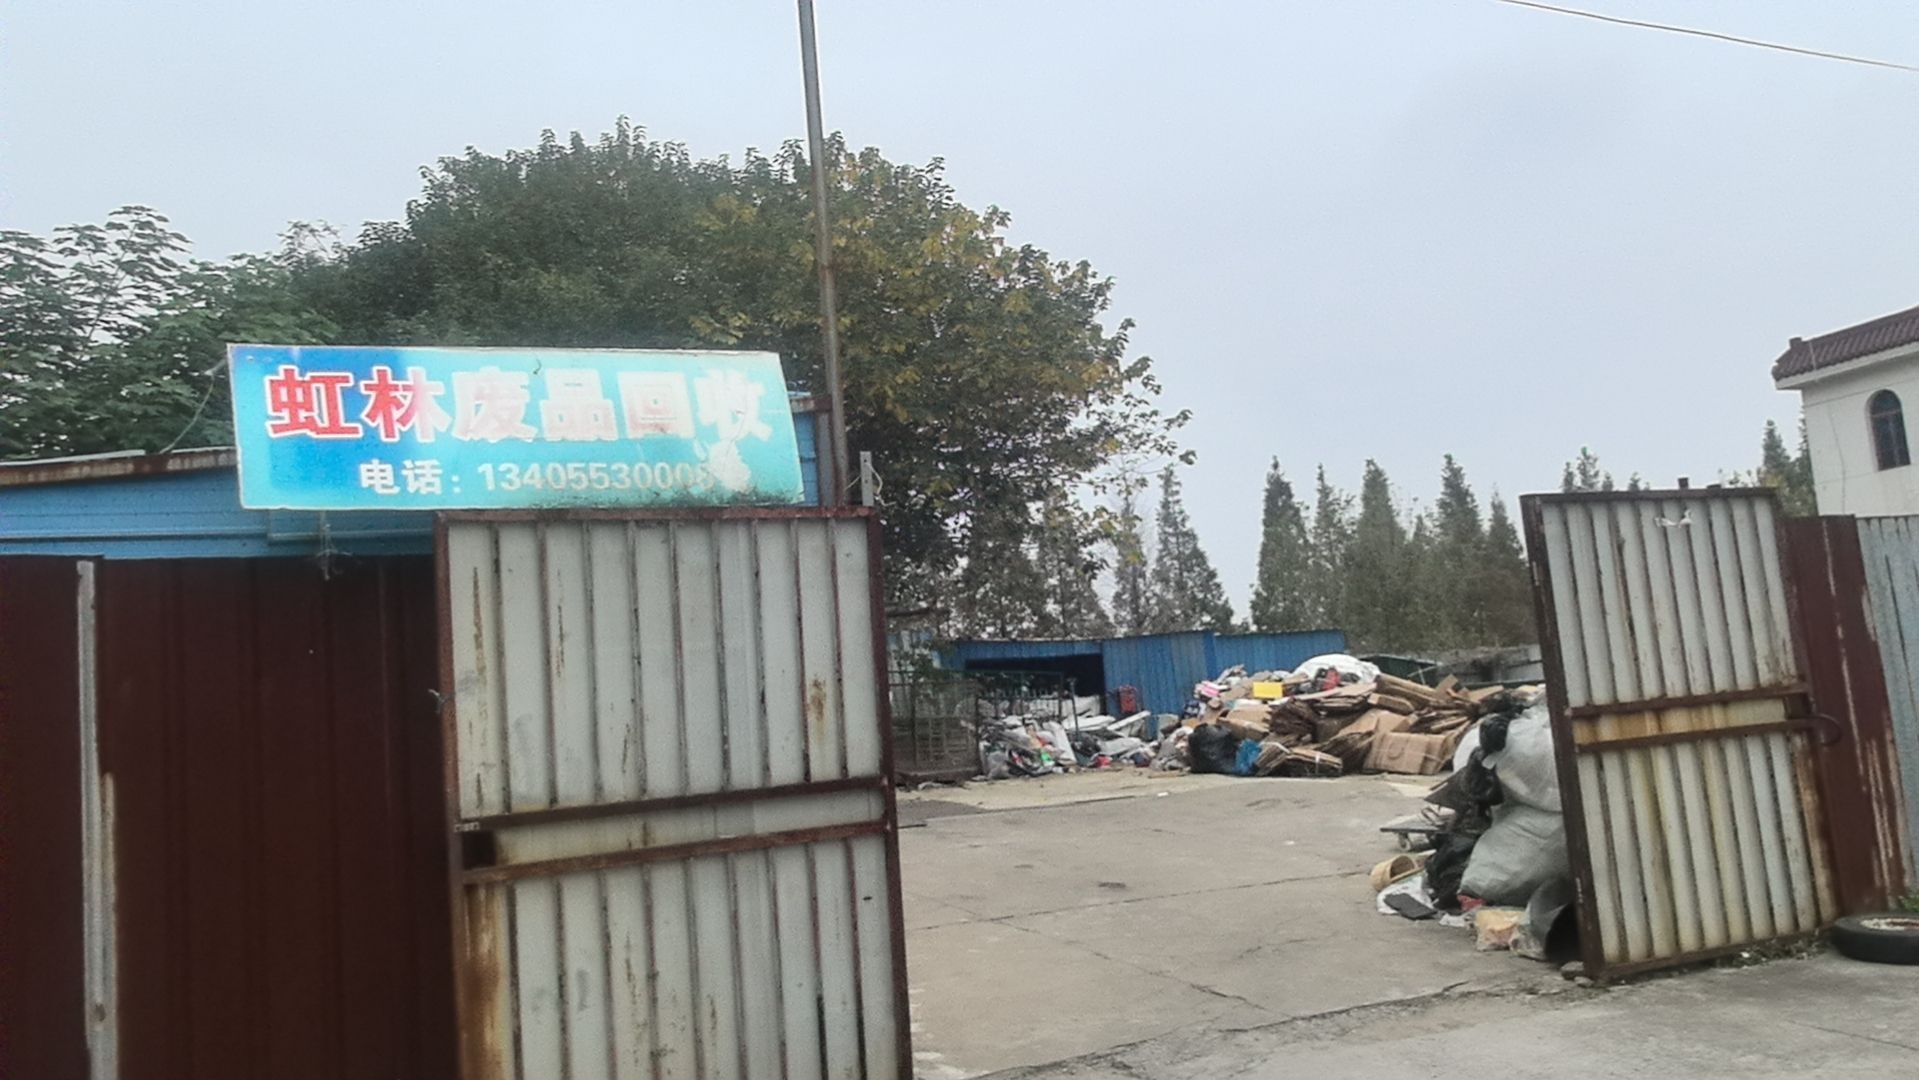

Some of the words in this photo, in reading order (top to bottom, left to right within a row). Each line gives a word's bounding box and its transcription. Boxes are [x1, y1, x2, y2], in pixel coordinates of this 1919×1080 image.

[265, 365, 772, 443] 虹林废品回收
